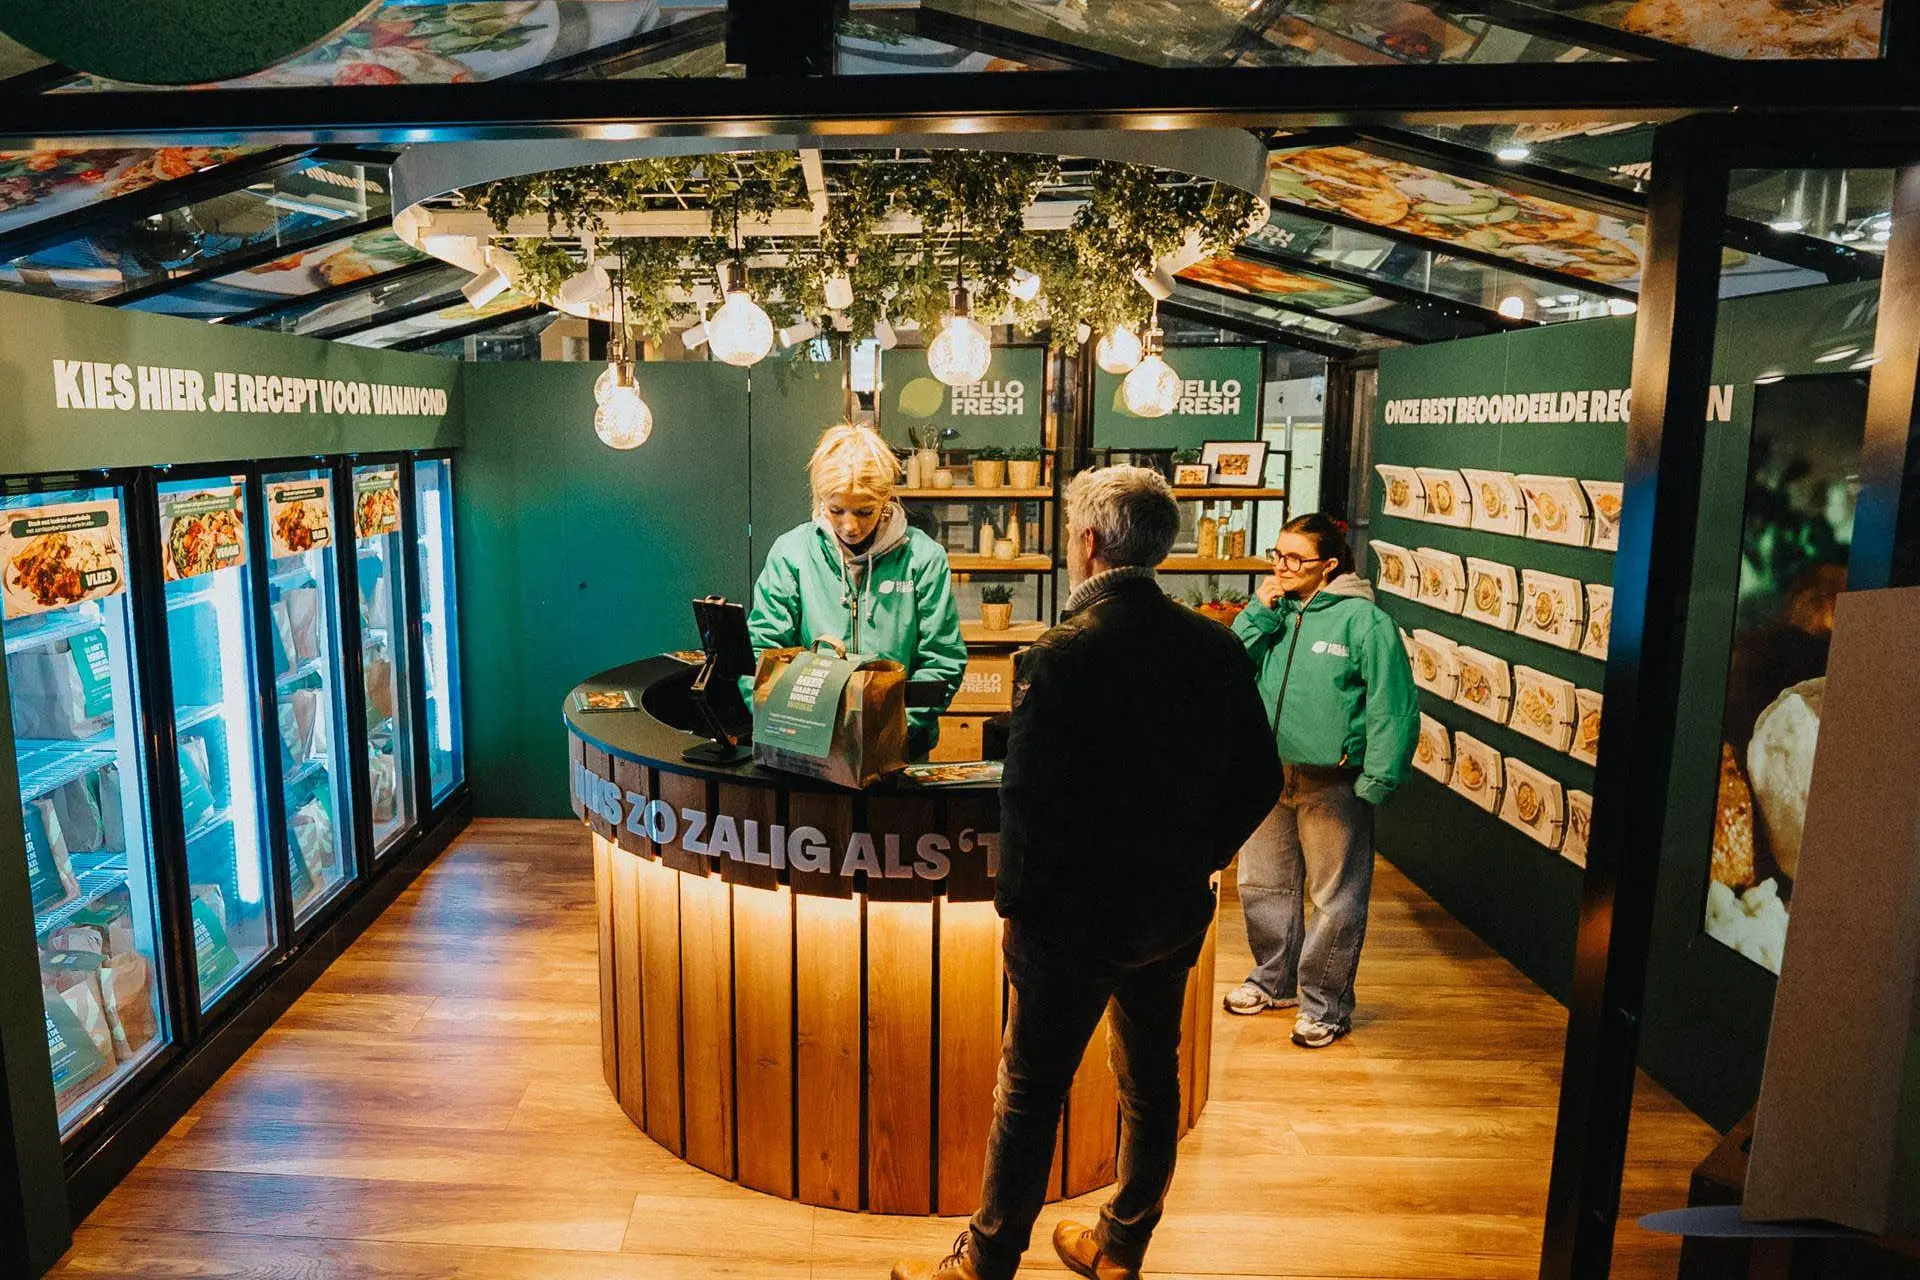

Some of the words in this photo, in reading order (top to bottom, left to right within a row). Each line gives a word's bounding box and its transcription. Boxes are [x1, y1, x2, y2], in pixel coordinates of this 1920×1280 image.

[53, 359, 135, 411] KIES
[137, 366, 206, 412] HIER
[208, 372, 238, 413] JE
[238, 374, 318, 413] RECEPT
[320, 379, 371, 415] VOOR
[371, 383, 448, 416] VANAVOND
[952, 380, 1024, 398] HELLO
[1180, 380, 1241, 398] ELLO
[951, 398, 1024, 415] FRESH
[1384, 399, 1421, 425] ONZE
[1420, 397, 1457, 424] BEST
[1456, 390, 1589, 424] BEOORDEELDE
[85, 570, 113, 587] VLEES
[963, 672, 1001, 684] HELLO
[960, 683, 1001, 693] FRESH
[625, 790, 678, 844] ZO
[681, 807, 831, 875] ZALIG
[840, 831, 951, 881] ALS
